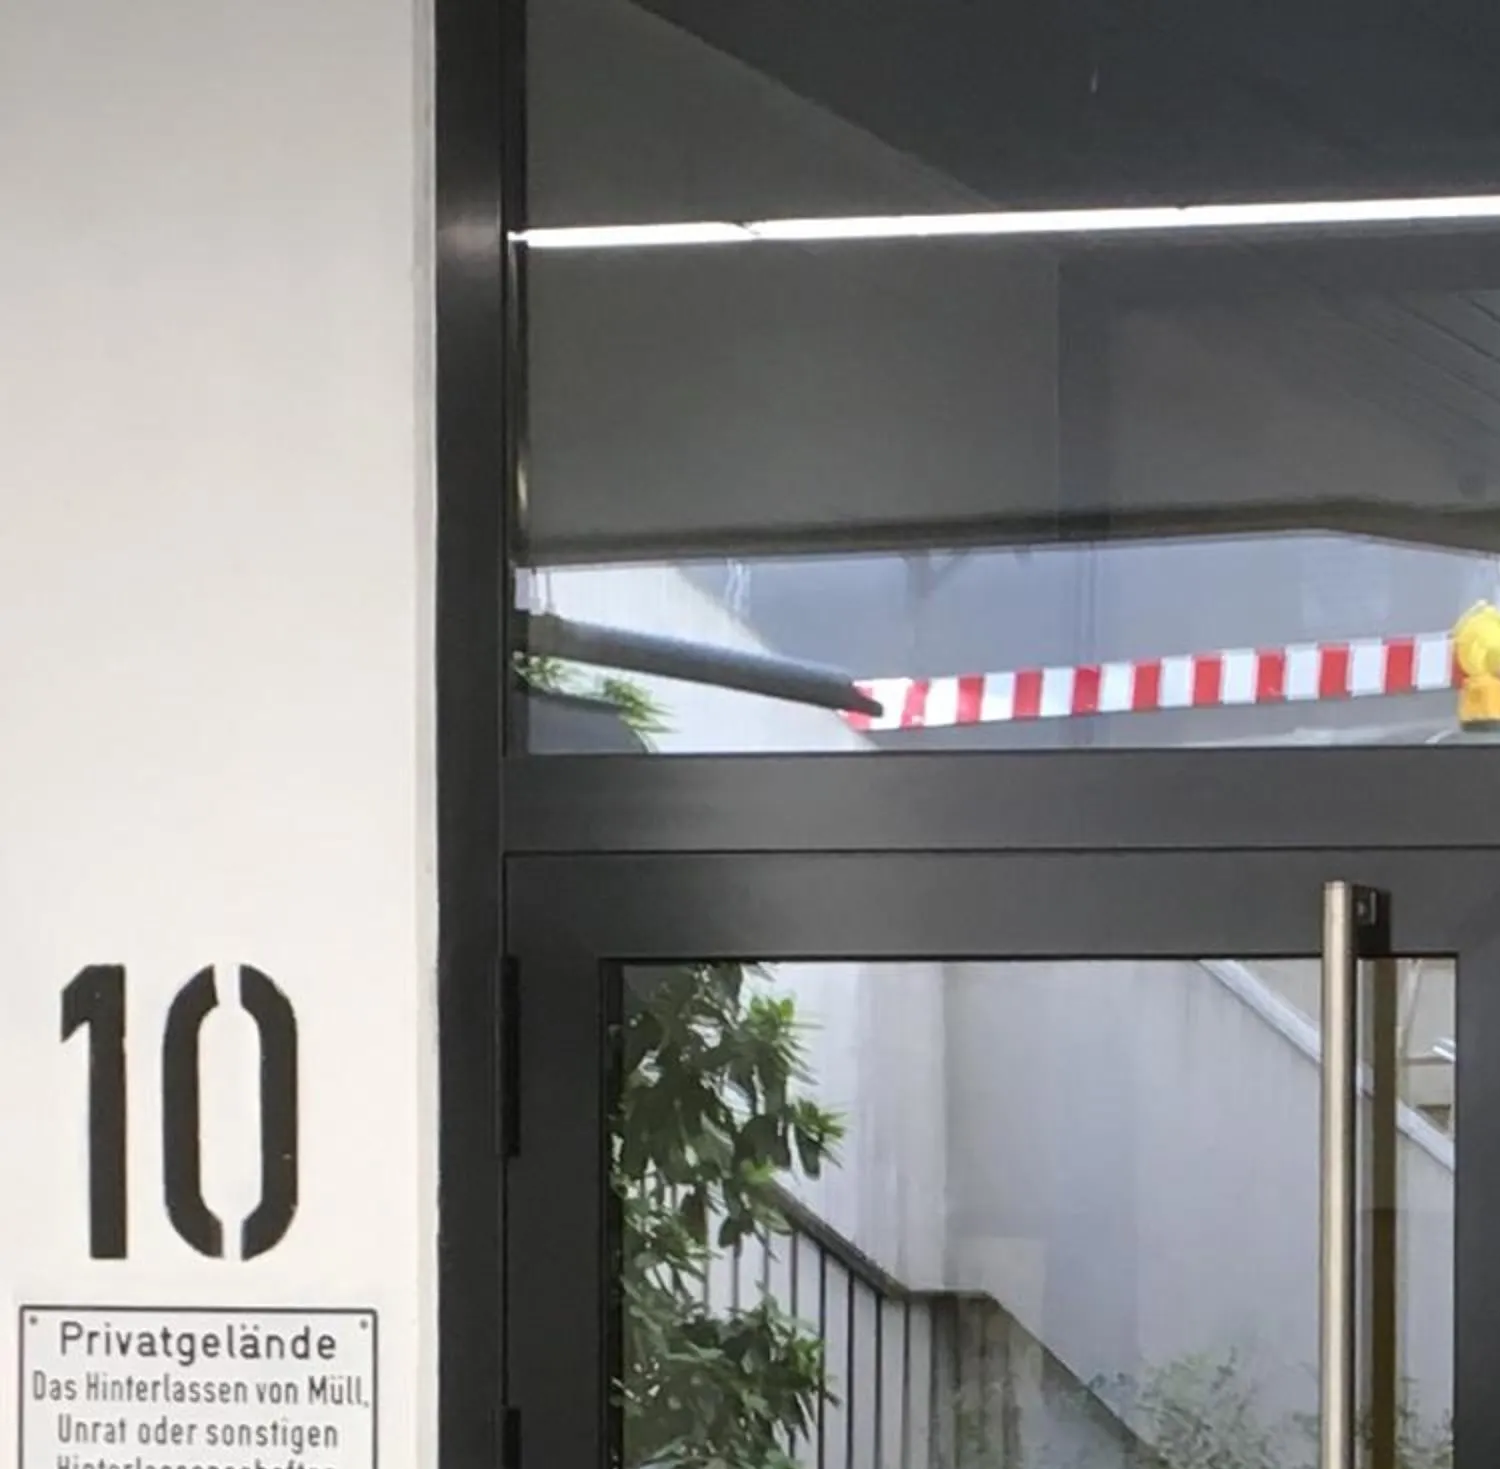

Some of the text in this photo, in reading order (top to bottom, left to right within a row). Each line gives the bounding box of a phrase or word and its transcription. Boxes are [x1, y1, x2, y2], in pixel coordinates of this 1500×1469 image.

[62, 965, 298, 1260] 10
[61, 1322, 336, 1366] Privatgelände
[33, 1371, 76, 1401] Das
[87, 1373, 247, 1403] Hinterlassen
[256, 1382, 298, 1404] von
[59, 1414, 337, 1453] Unrat oder sonstigen
